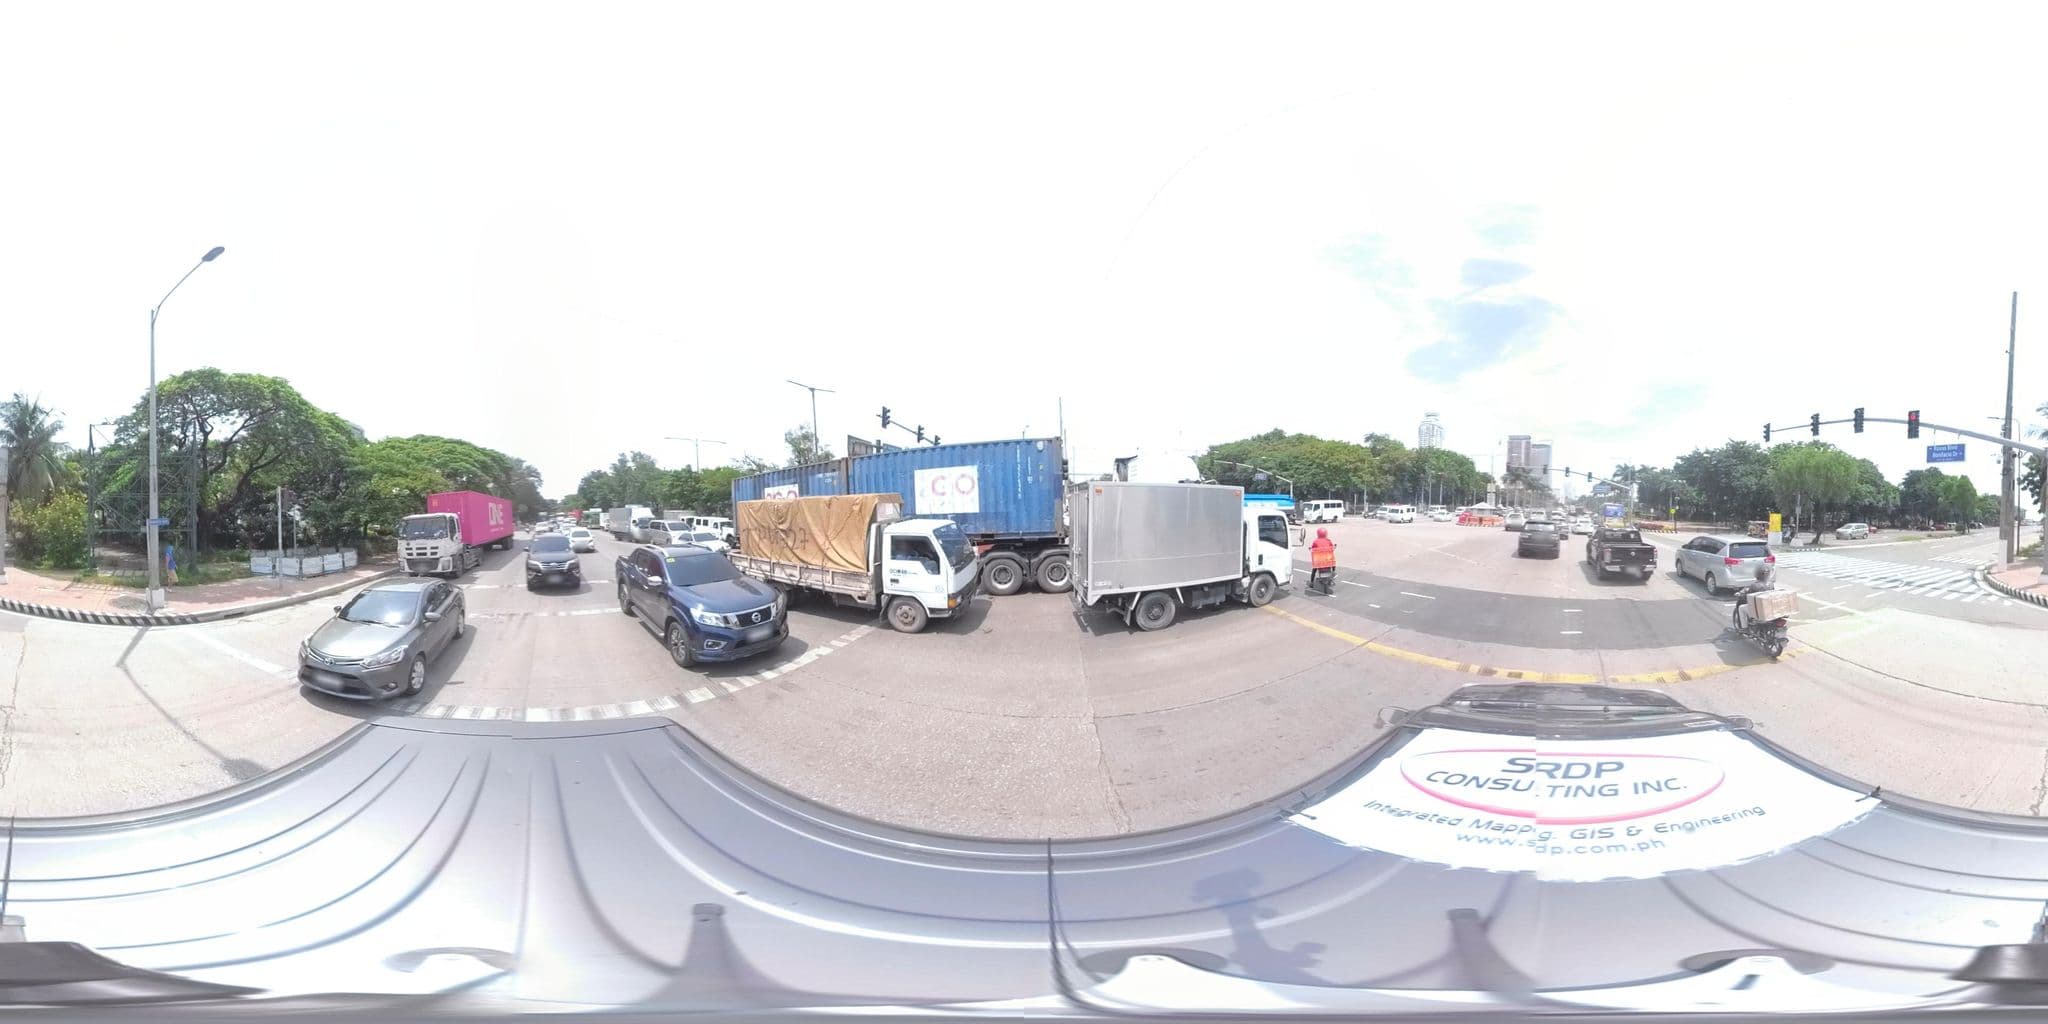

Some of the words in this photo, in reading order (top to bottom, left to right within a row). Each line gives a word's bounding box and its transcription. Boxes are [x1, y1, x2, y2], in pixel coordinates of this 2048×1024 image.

[1501, 757, 1625, 779] SRDP
[1426, 771, 1620, 798] CONSUTING
[1633, 777, 1688, 795] INC.
[1363, 800, 1464, 827] Integrated
[1570, 826, 1615, 840] GIS
[1626, 825, 1643, 837] &
[1654, 806, 1766, 834] Engineering
[1456, 833, 1666, 855] www.sdp.com.ph
